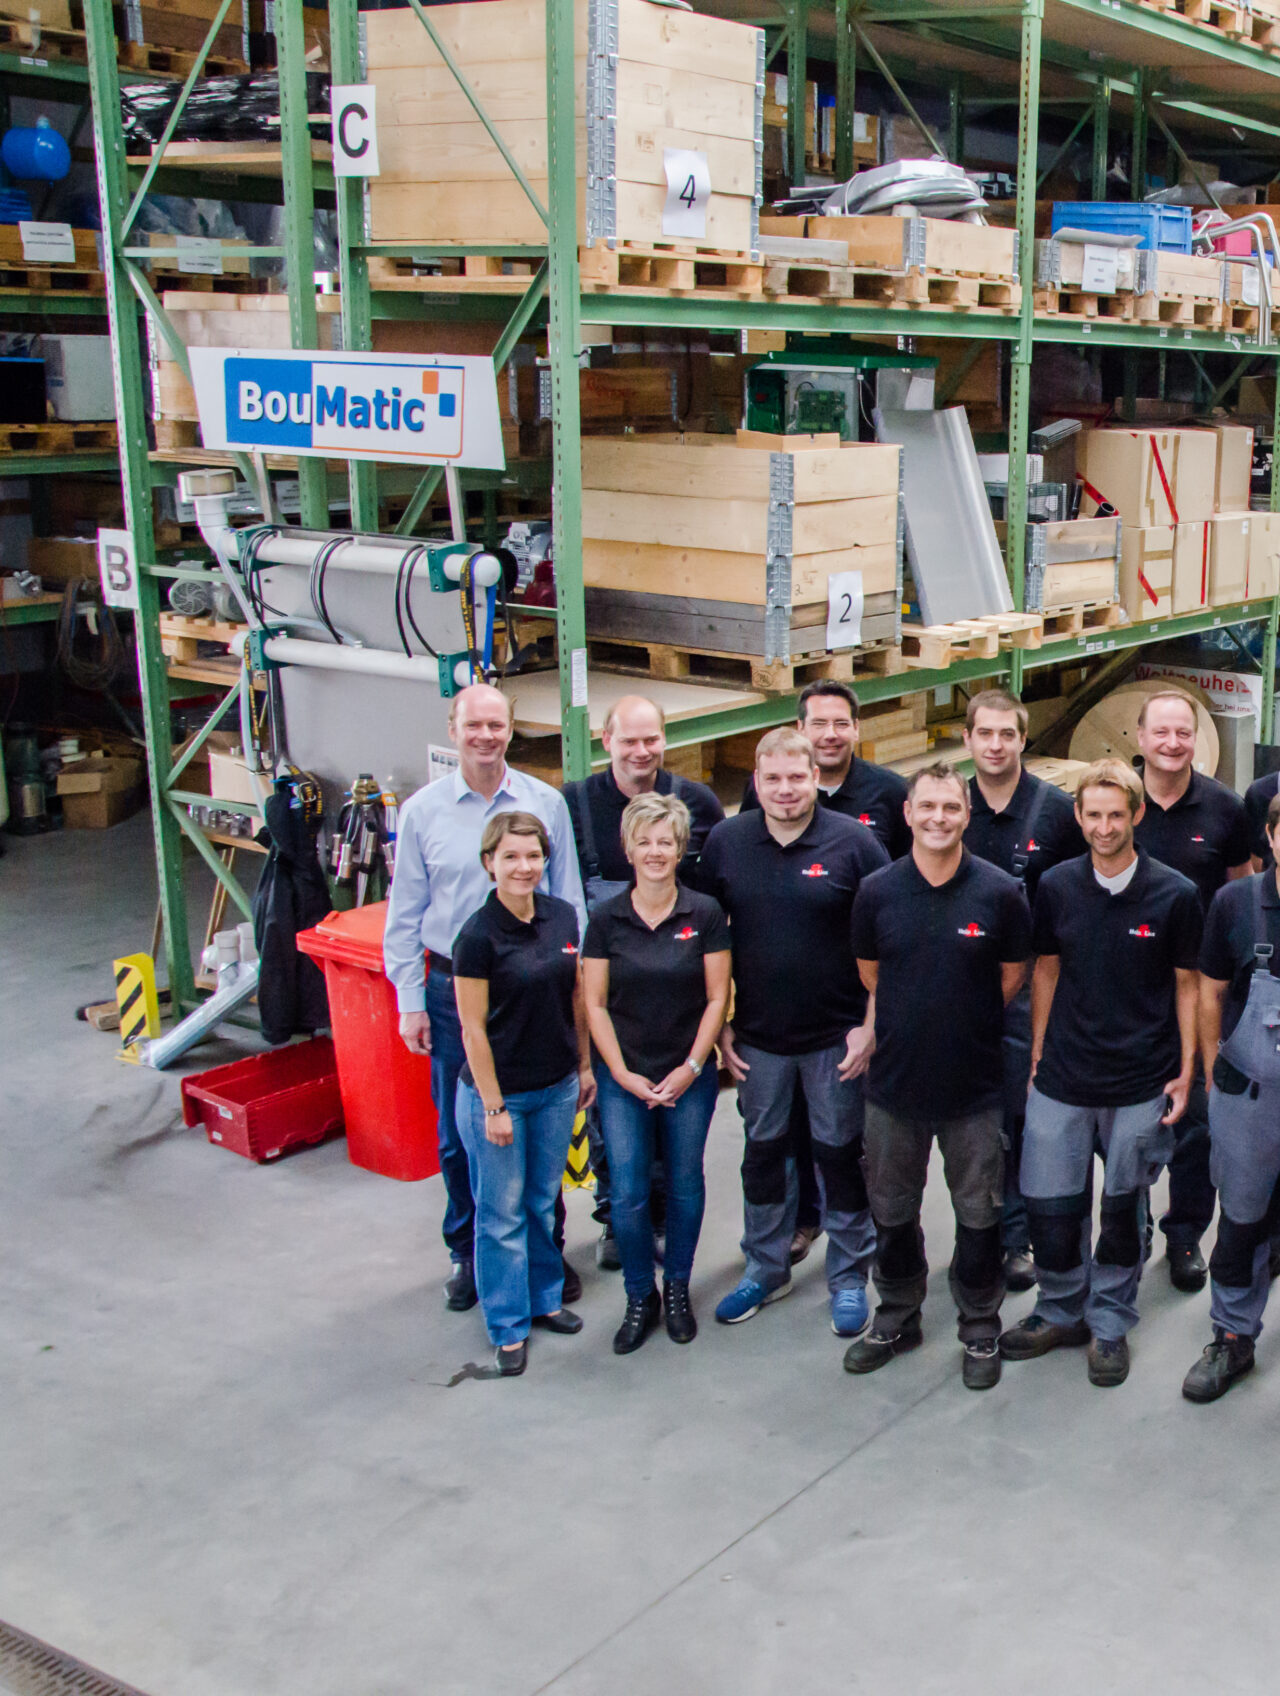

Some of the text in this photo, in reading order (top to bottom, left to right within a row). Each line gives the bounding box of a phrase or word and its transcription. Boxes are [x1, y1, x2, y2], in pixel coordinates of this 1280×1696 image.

[338, 103, 370, 159] C
[679, 174, 697, 209] 4
[238, 380, 426, 433] BouMatic
[105, 545, 132, 592] B
[839, 593, 852, 623] 2
